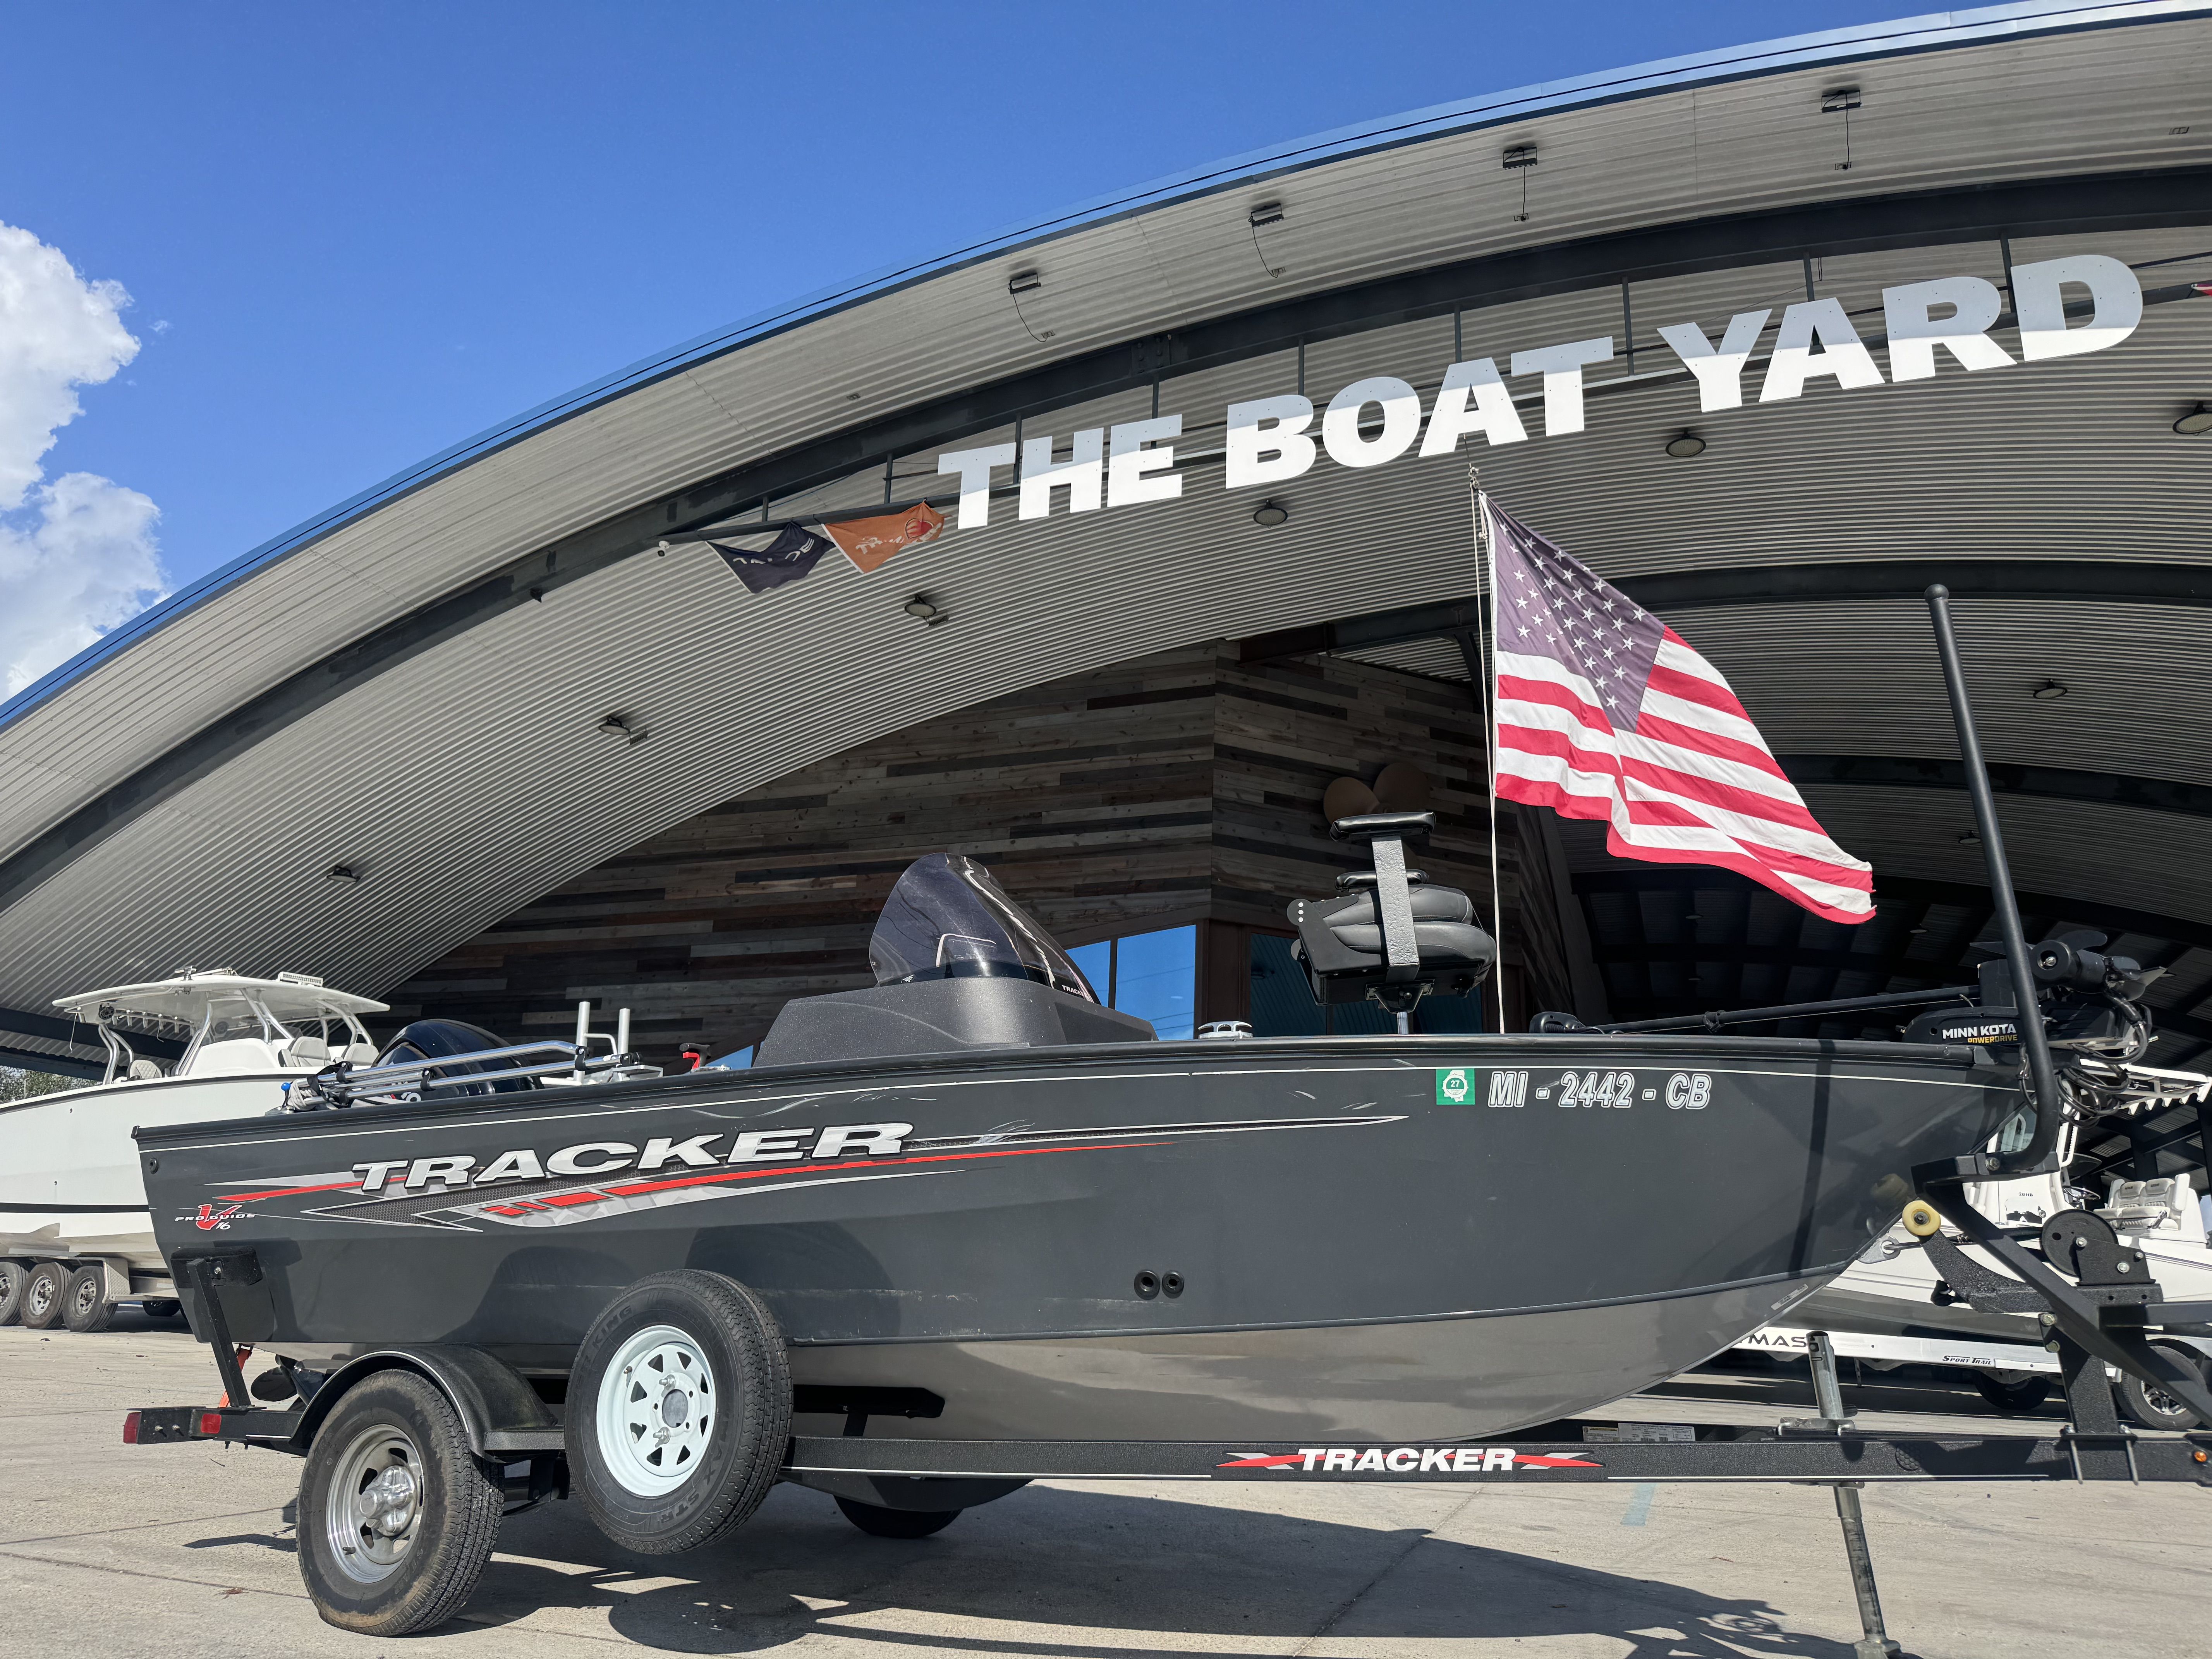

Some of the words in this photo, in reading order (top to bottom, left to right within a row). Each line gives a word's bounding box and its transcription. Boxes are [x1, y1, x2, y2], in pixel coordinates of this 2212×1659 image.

[938, 414, 1182, 530] THE
[1226, 336, 1614, 489] BOAT
[1657, 254, 2143, 412] YARD
[1061, 984, 1084, 996] TRACK
[1942, 1026, 1977, 1039] MINN
[1980, 1024, 2016, 1036] KOTA
[1967, 1034, 2018, 1044] POWERDRIVE
[1488, 1071, 1528, 1108] MI
[1558, 1071, 1635, 1108] 2442
[1665, 1072, 1712, 1109] CB
[352, 1121, 915, 1192] TRACKER
[216, 1221, 231, 1230] 16
[1747, 1334, 1807, 1348] MAS
[1297, 1448, 1517, 1472] TRACKER
